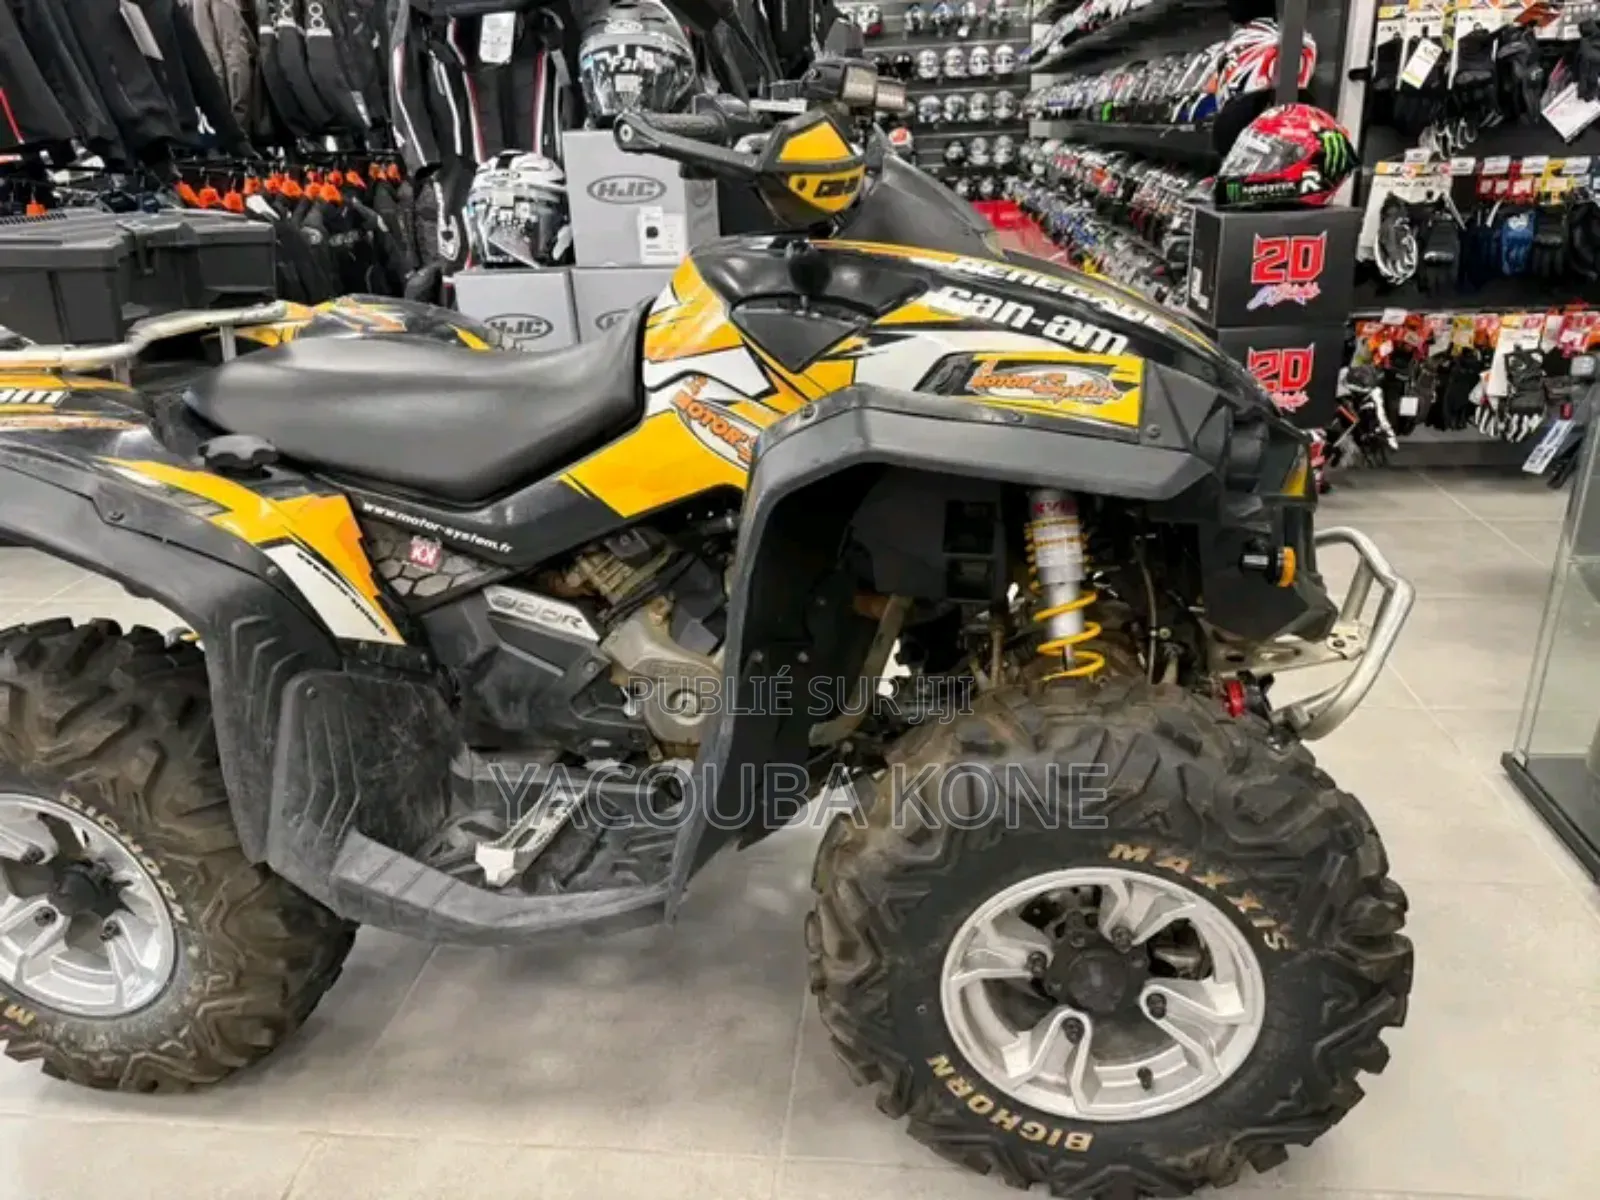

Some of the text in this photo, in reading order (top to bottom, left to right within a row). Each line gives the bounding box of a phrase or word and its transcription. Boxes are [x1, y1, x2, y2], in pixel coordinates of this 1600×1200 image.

[597, 182, 656, 196] HJC
[930, 286, 1129, 355] can-am
[362, 501, 513, 554] www.motor-system.fr
[1108, 843, 1290, 951] MAXXIS
[926, 1054, 1094, 1153] BIGHORN
